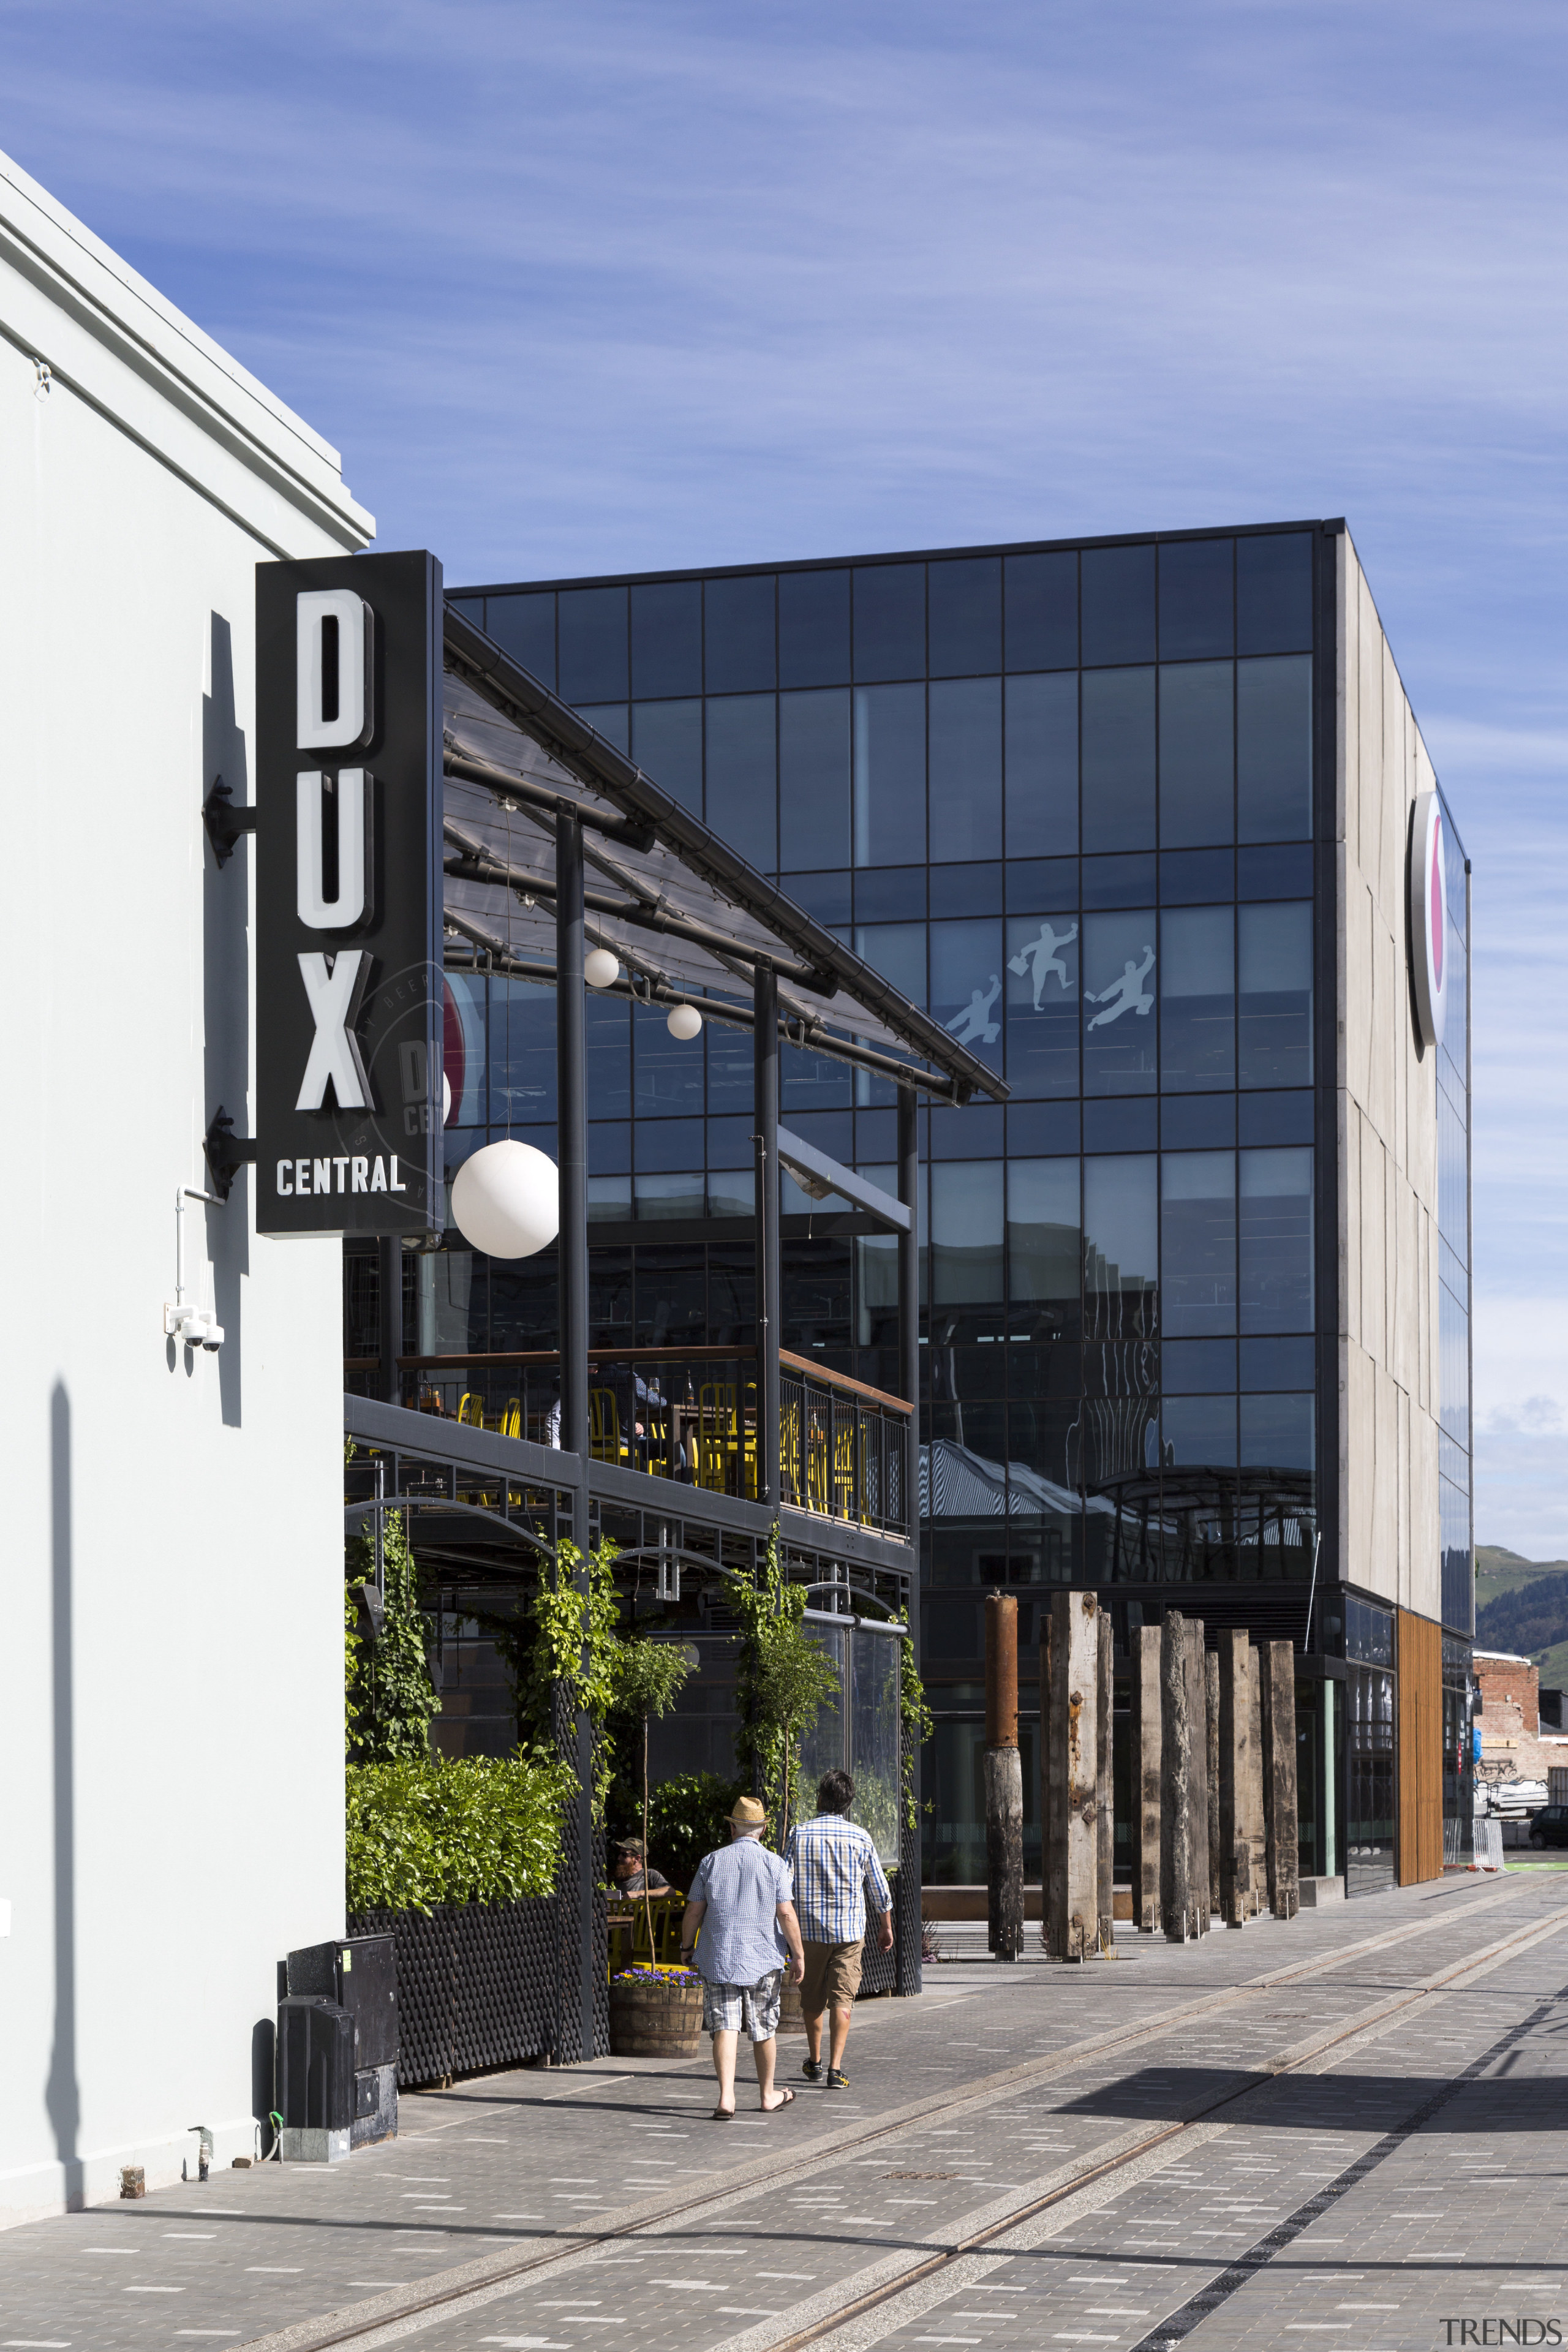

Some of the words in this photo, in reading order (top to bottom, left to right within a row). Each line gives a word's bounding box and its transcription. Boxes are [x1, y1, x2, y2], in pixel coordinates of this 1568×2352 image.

[296, 589, 370, 1111] DUX
[383, 974, 429, 1009] BEER
[277, 1155, 405, 1196] CENTRAL
